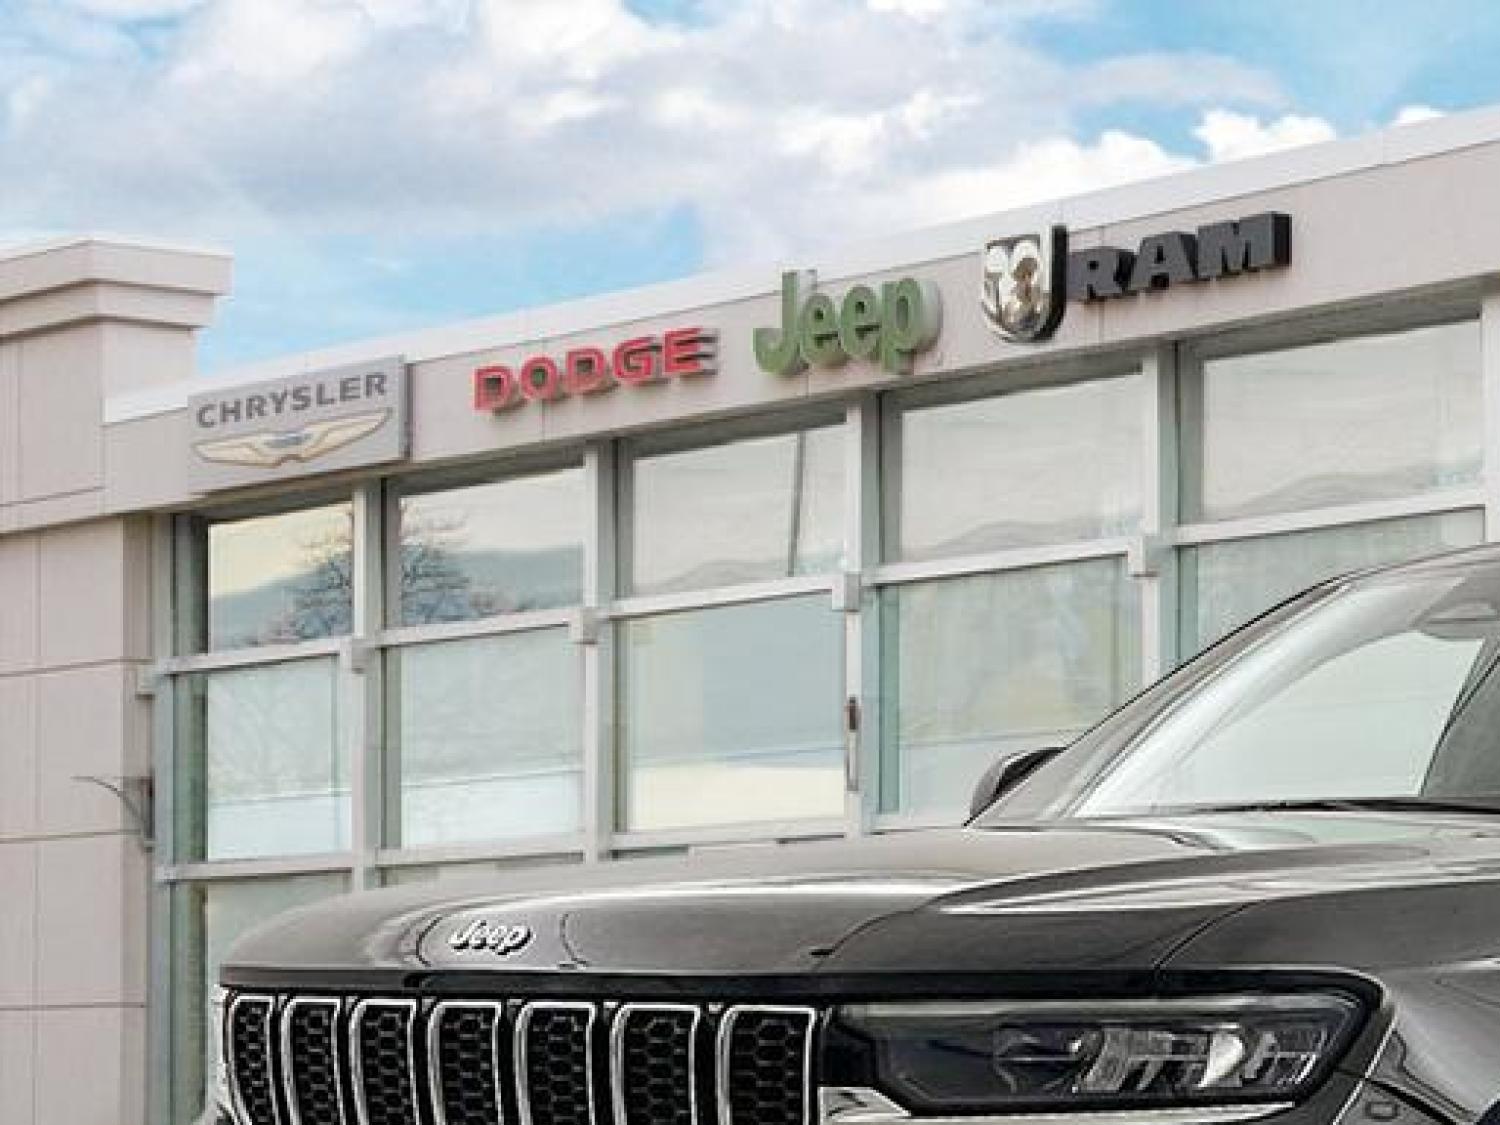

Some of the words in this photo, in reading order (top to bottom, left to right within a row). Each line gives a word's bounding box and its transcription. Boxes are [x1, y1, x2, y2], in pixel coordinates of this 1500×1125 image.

[1066, 211, 1292, 303] RAM
[753, 269, 942, 375] Jeep
[196, 372, 386, 428] CHRYSLER
[473, 327, 717, 412] DODGE
[447, 919, 533, 957] Jeep
